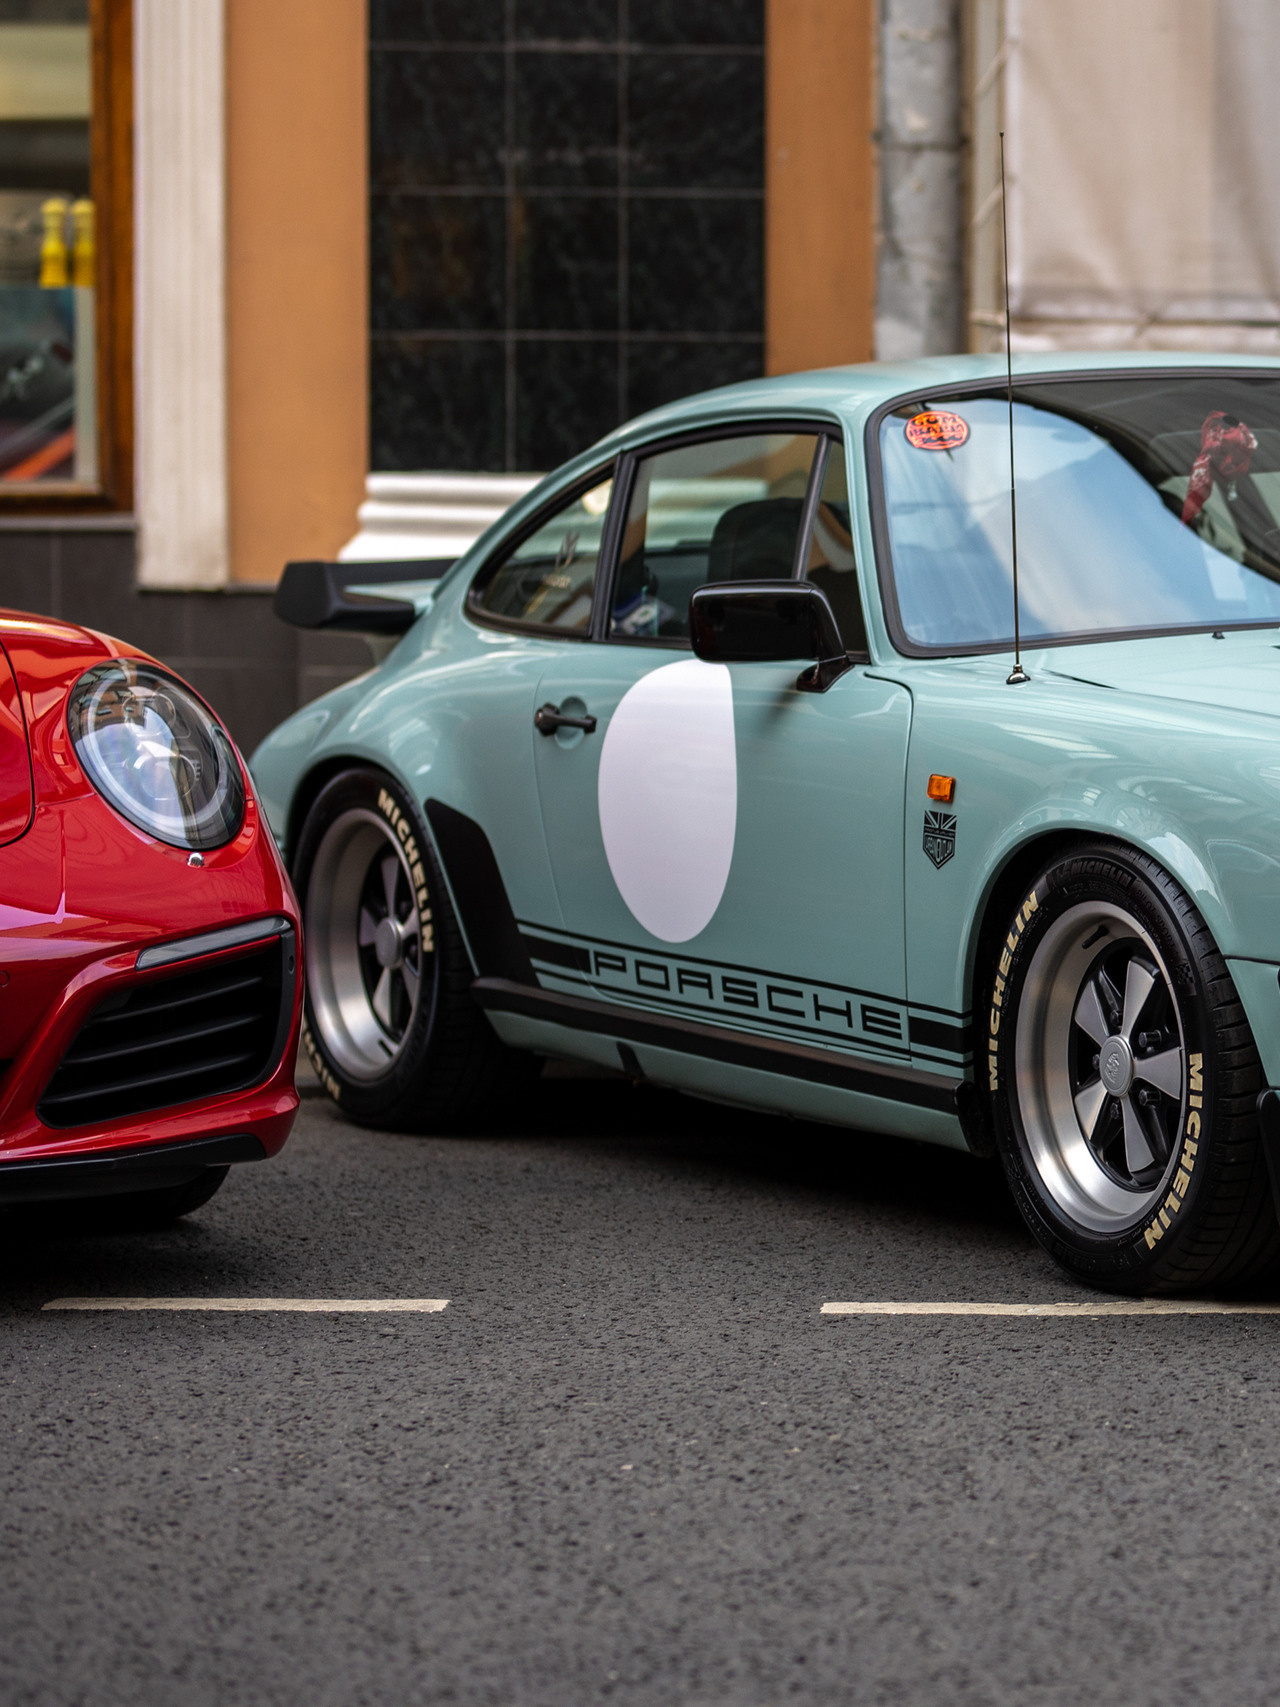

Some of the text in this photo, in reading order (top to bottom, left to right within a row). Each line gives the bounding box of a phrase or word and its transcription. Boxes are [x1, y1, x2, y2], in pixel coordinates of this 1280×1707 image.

[378, 788, 435, 952] MICHELIN
[1070, 860, 1133, 889] MICHELIN
[594, 950, 903, 1041] PORSCHE
[987, 890, 1040, 1091] MICHELIN
[1143, 1052, 1204, 1251] MICHELIN
